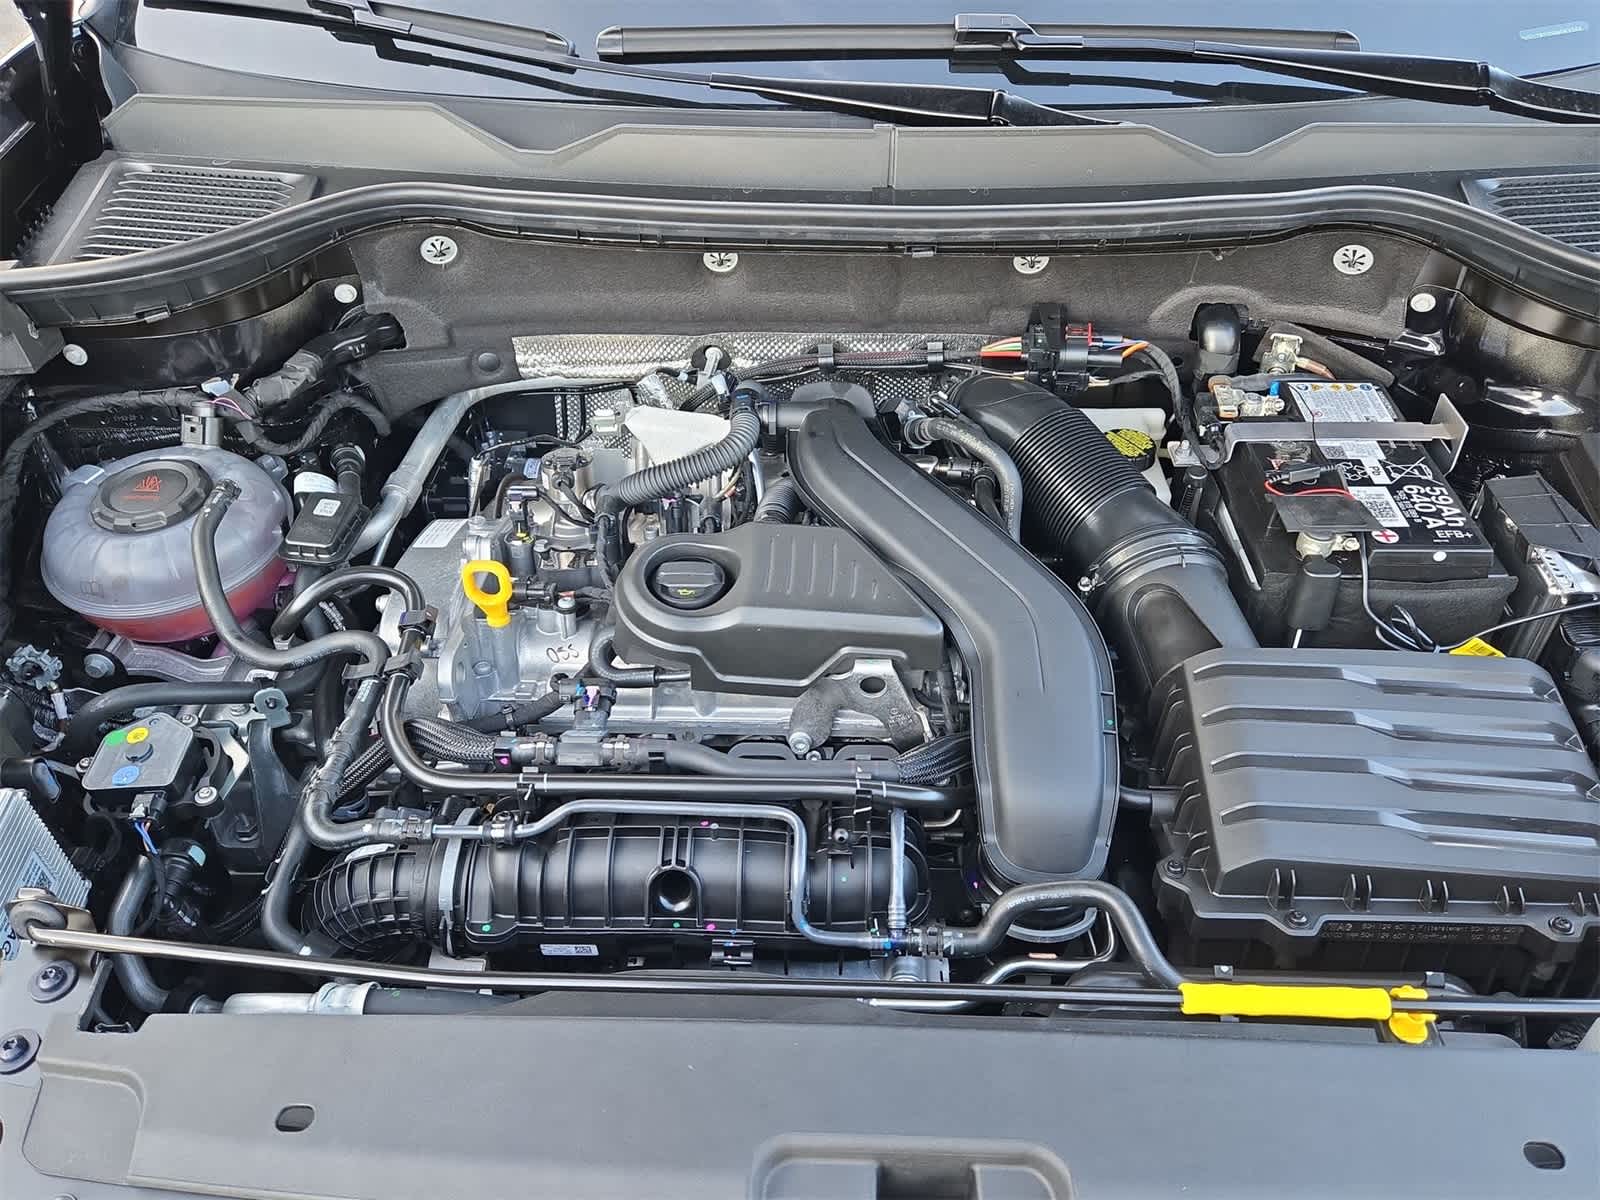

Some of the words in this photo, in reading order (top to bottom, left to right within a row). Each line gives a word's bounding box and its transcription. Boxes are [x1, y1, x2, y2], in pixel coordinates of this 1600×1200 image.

[1403, 484, 1435, 513] 640
[1421, 516, 1443, 529] A
[1425, 485, 1467, 528] 59Ah
[1435, 530, 1474, 539] EFB+
